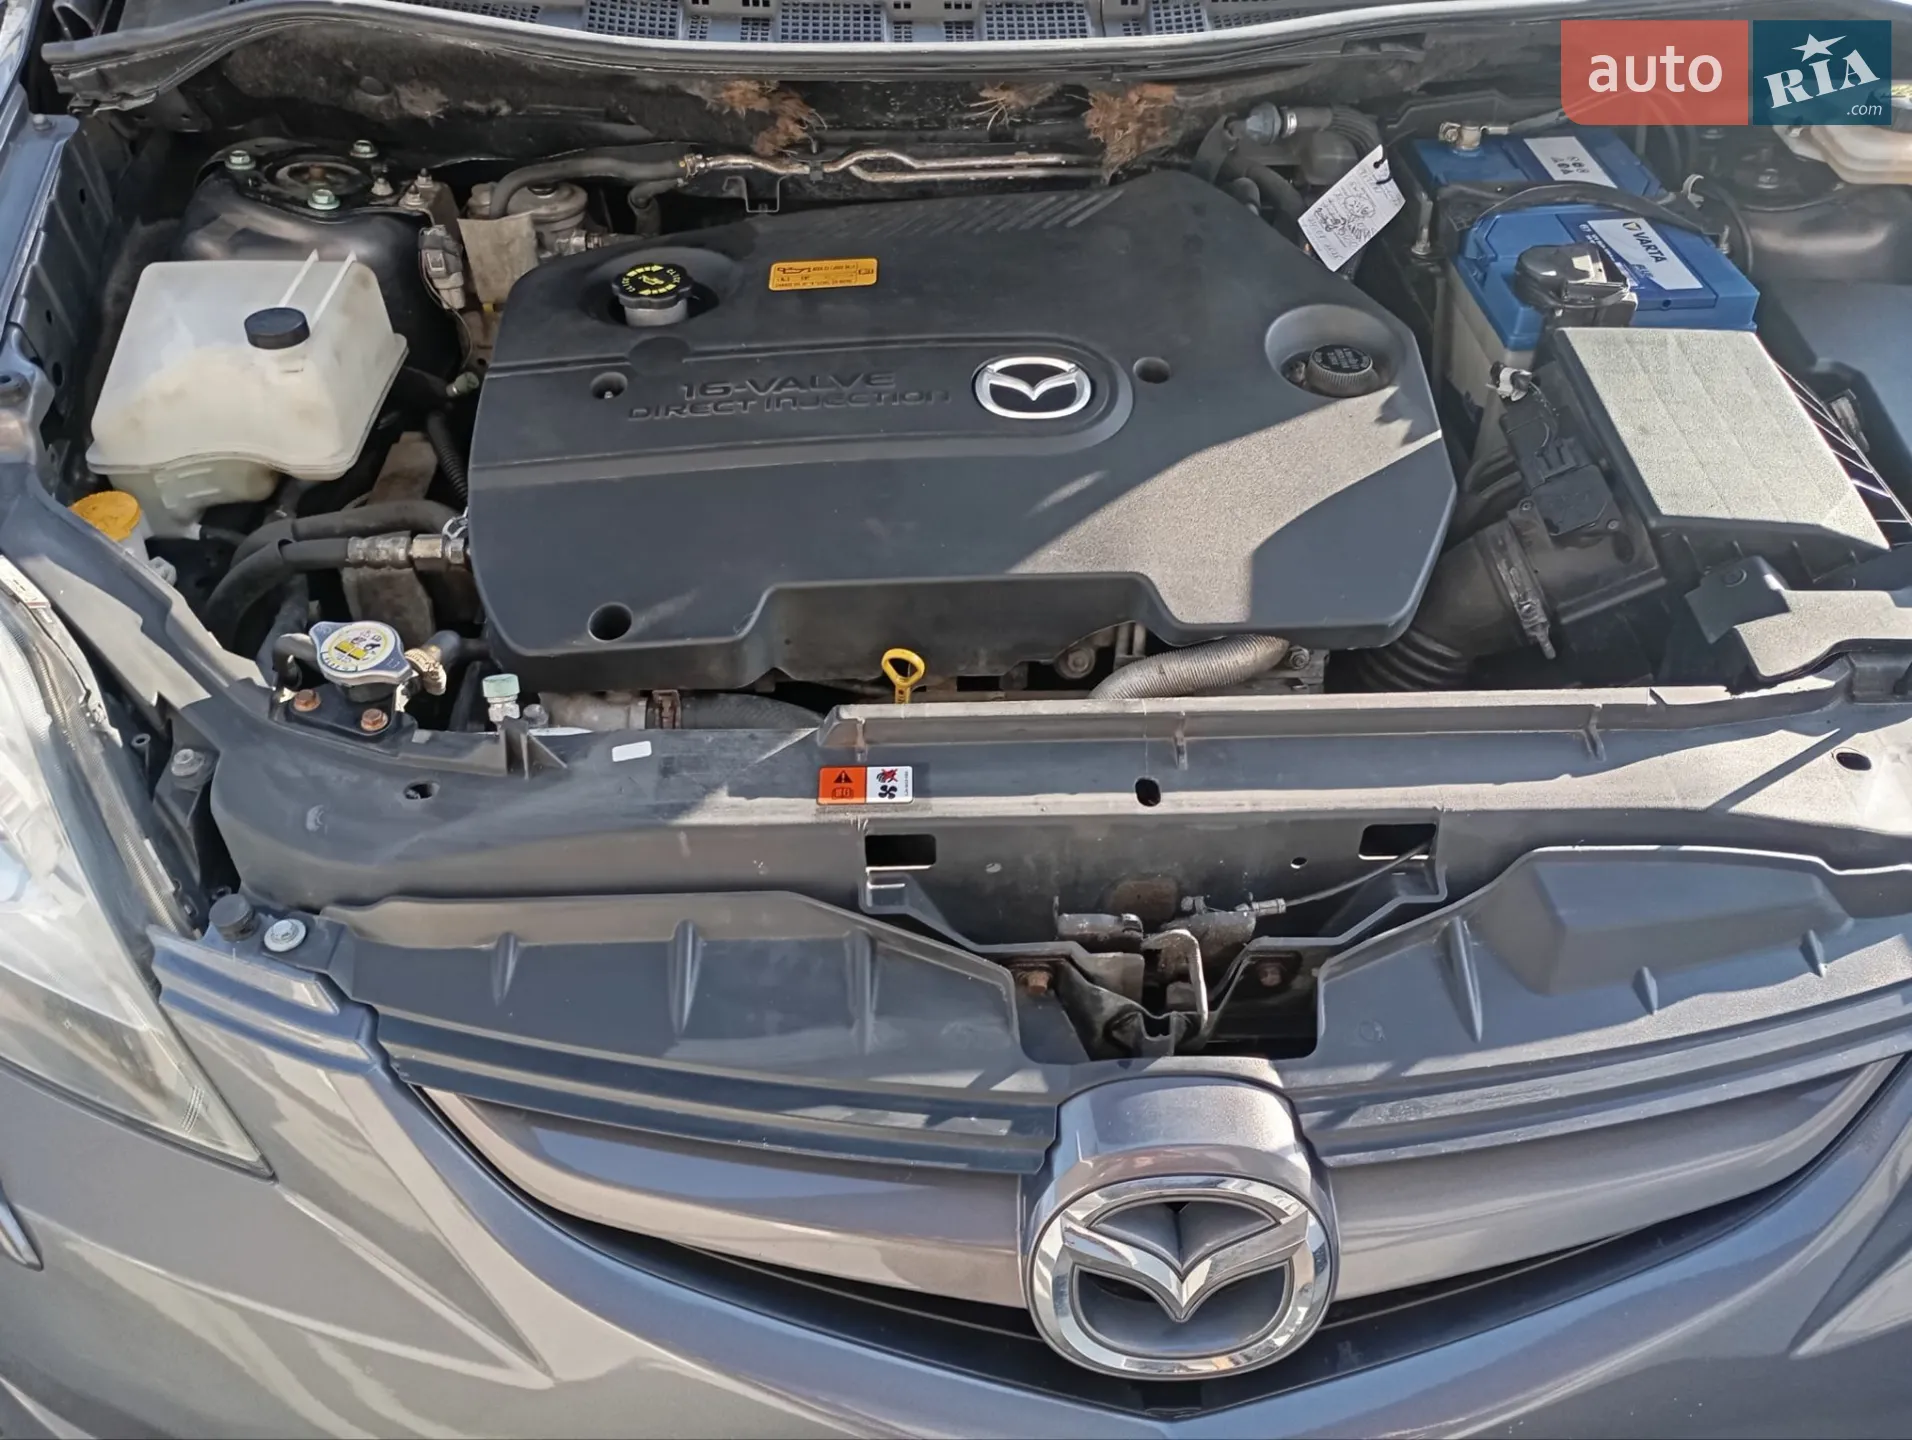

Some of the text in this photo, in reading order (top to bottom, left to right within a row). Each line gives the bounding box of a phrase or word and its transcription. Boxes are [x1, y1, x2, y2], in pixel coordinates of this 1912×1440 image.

[1632, 231, 1667, 263] VARTA
[680, 372, 896, 401] 16-VALVE
[628, 390, 951, 421] DIRECT INJECTION
